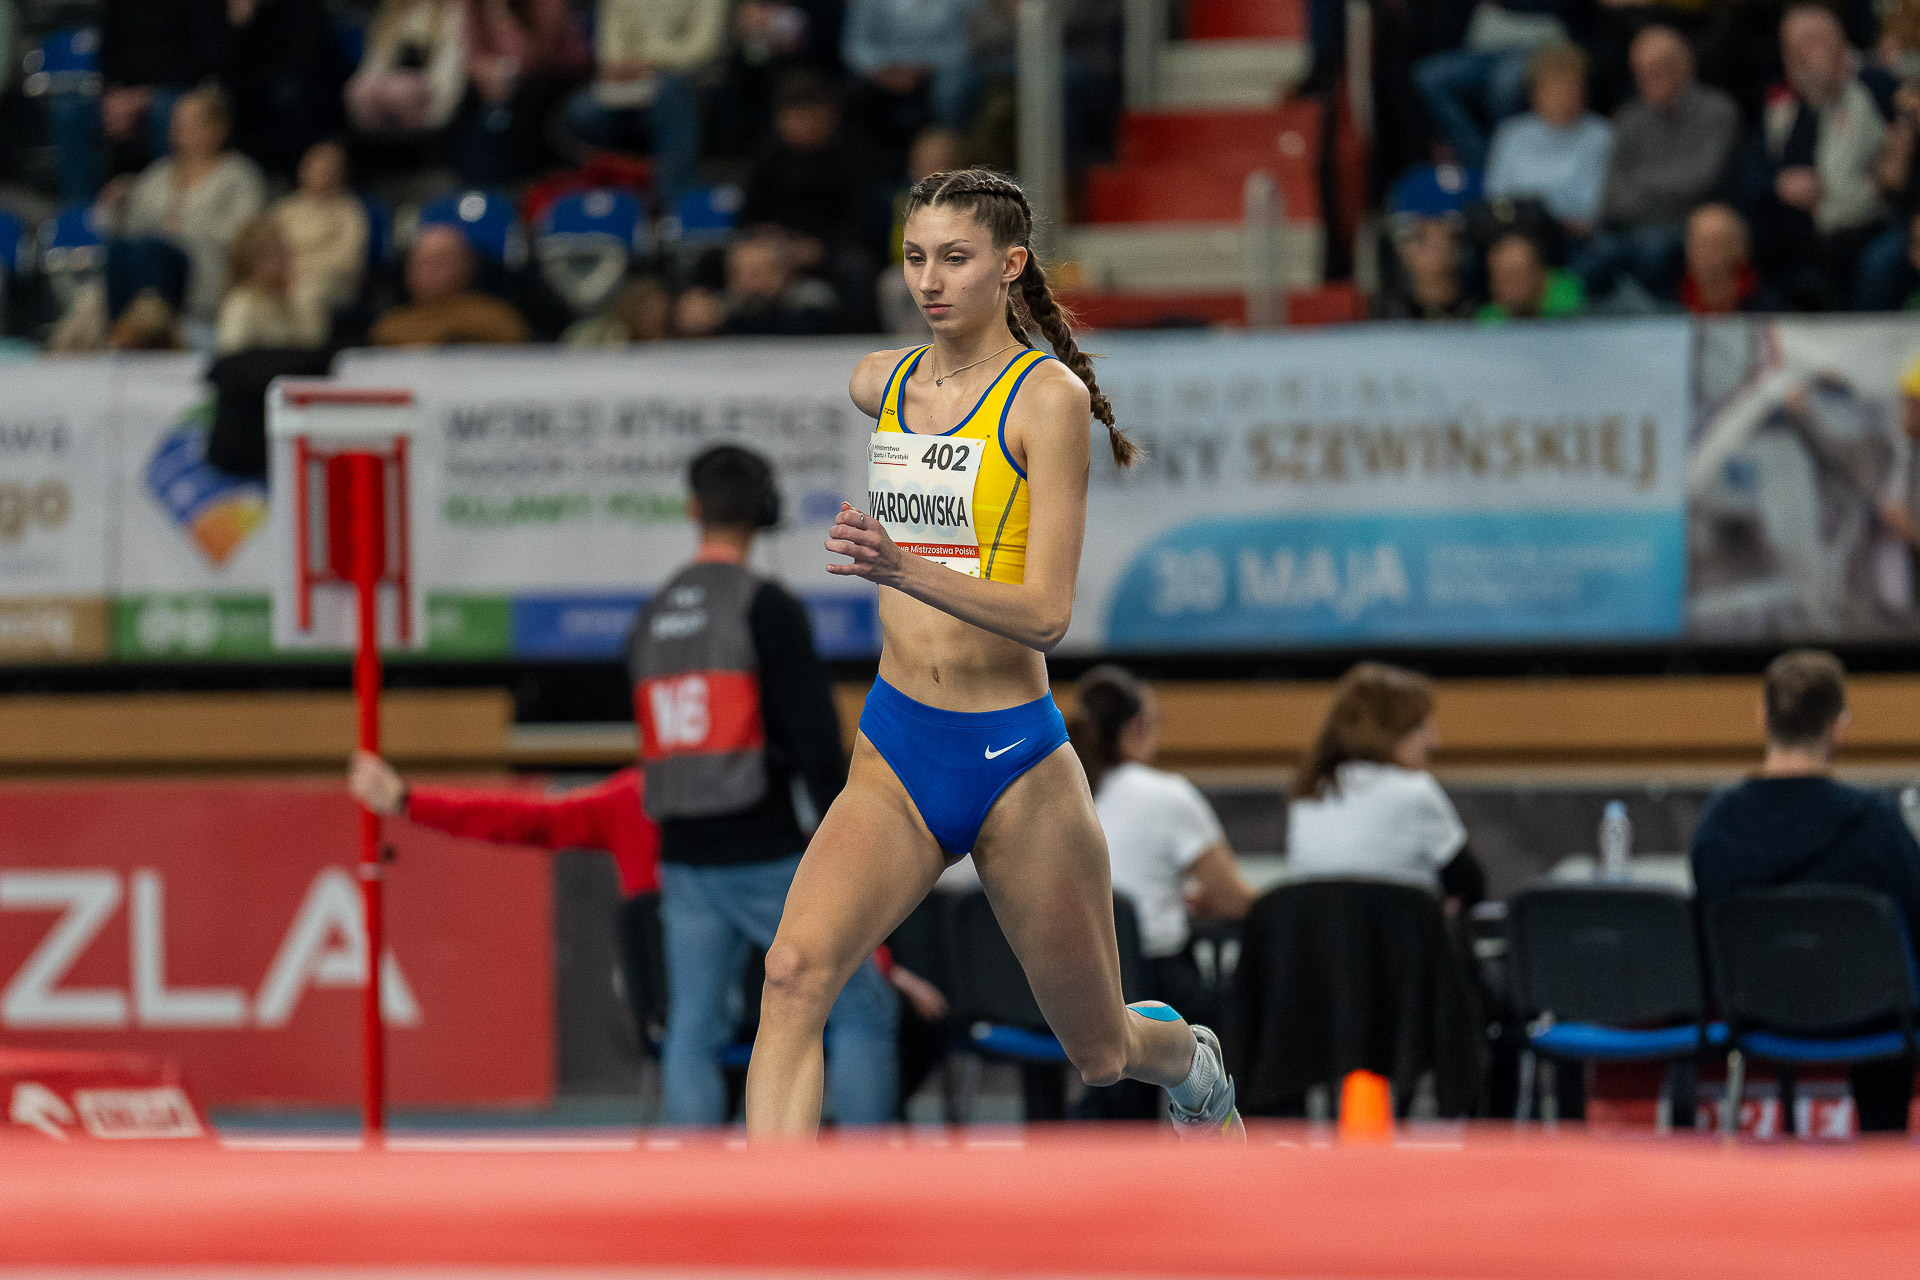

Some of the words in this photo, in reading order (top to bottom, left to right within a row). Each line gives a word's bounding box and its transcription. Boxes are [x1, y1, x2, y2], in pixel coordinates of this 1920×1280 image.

[921, 443, 970, 472] 402
[910, 544, 954, 555] Mistrzostwa
[954, 547, 976, 556] Polski
[1238, 545, 1408, 620] MAJA
[0, 866, 424, 1030] ZLA
